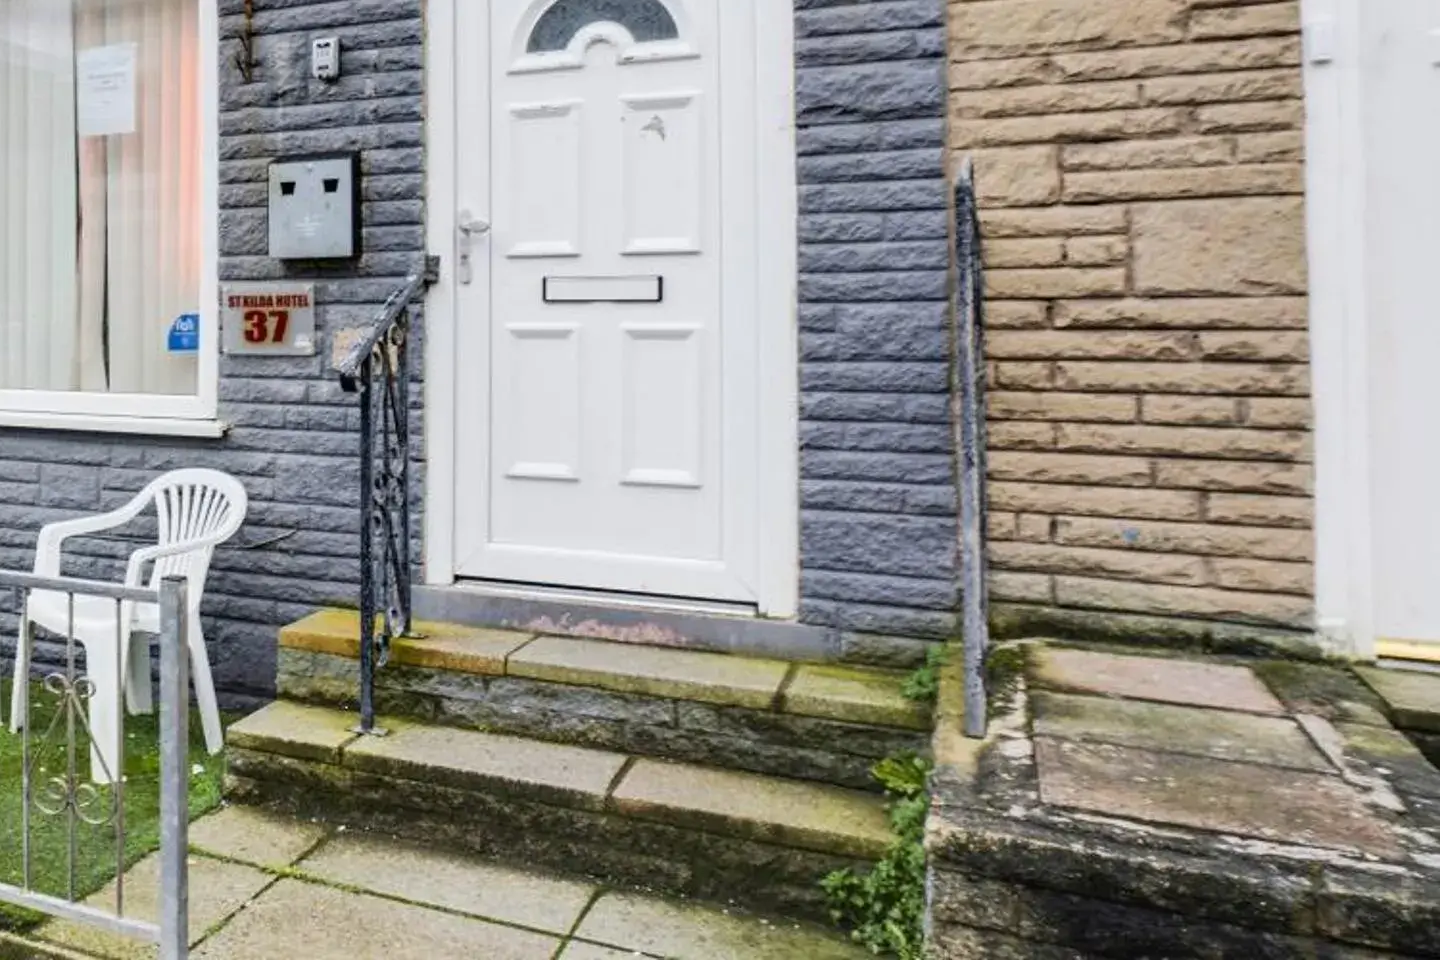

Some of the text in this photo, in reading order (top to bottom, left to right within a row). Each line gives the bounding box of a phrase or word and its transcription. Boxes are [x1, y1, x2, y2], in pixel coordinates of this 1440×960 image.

[227, 293, 309, 309] ST KILDA HOTEL
[244, 310, 289, 343] 37
